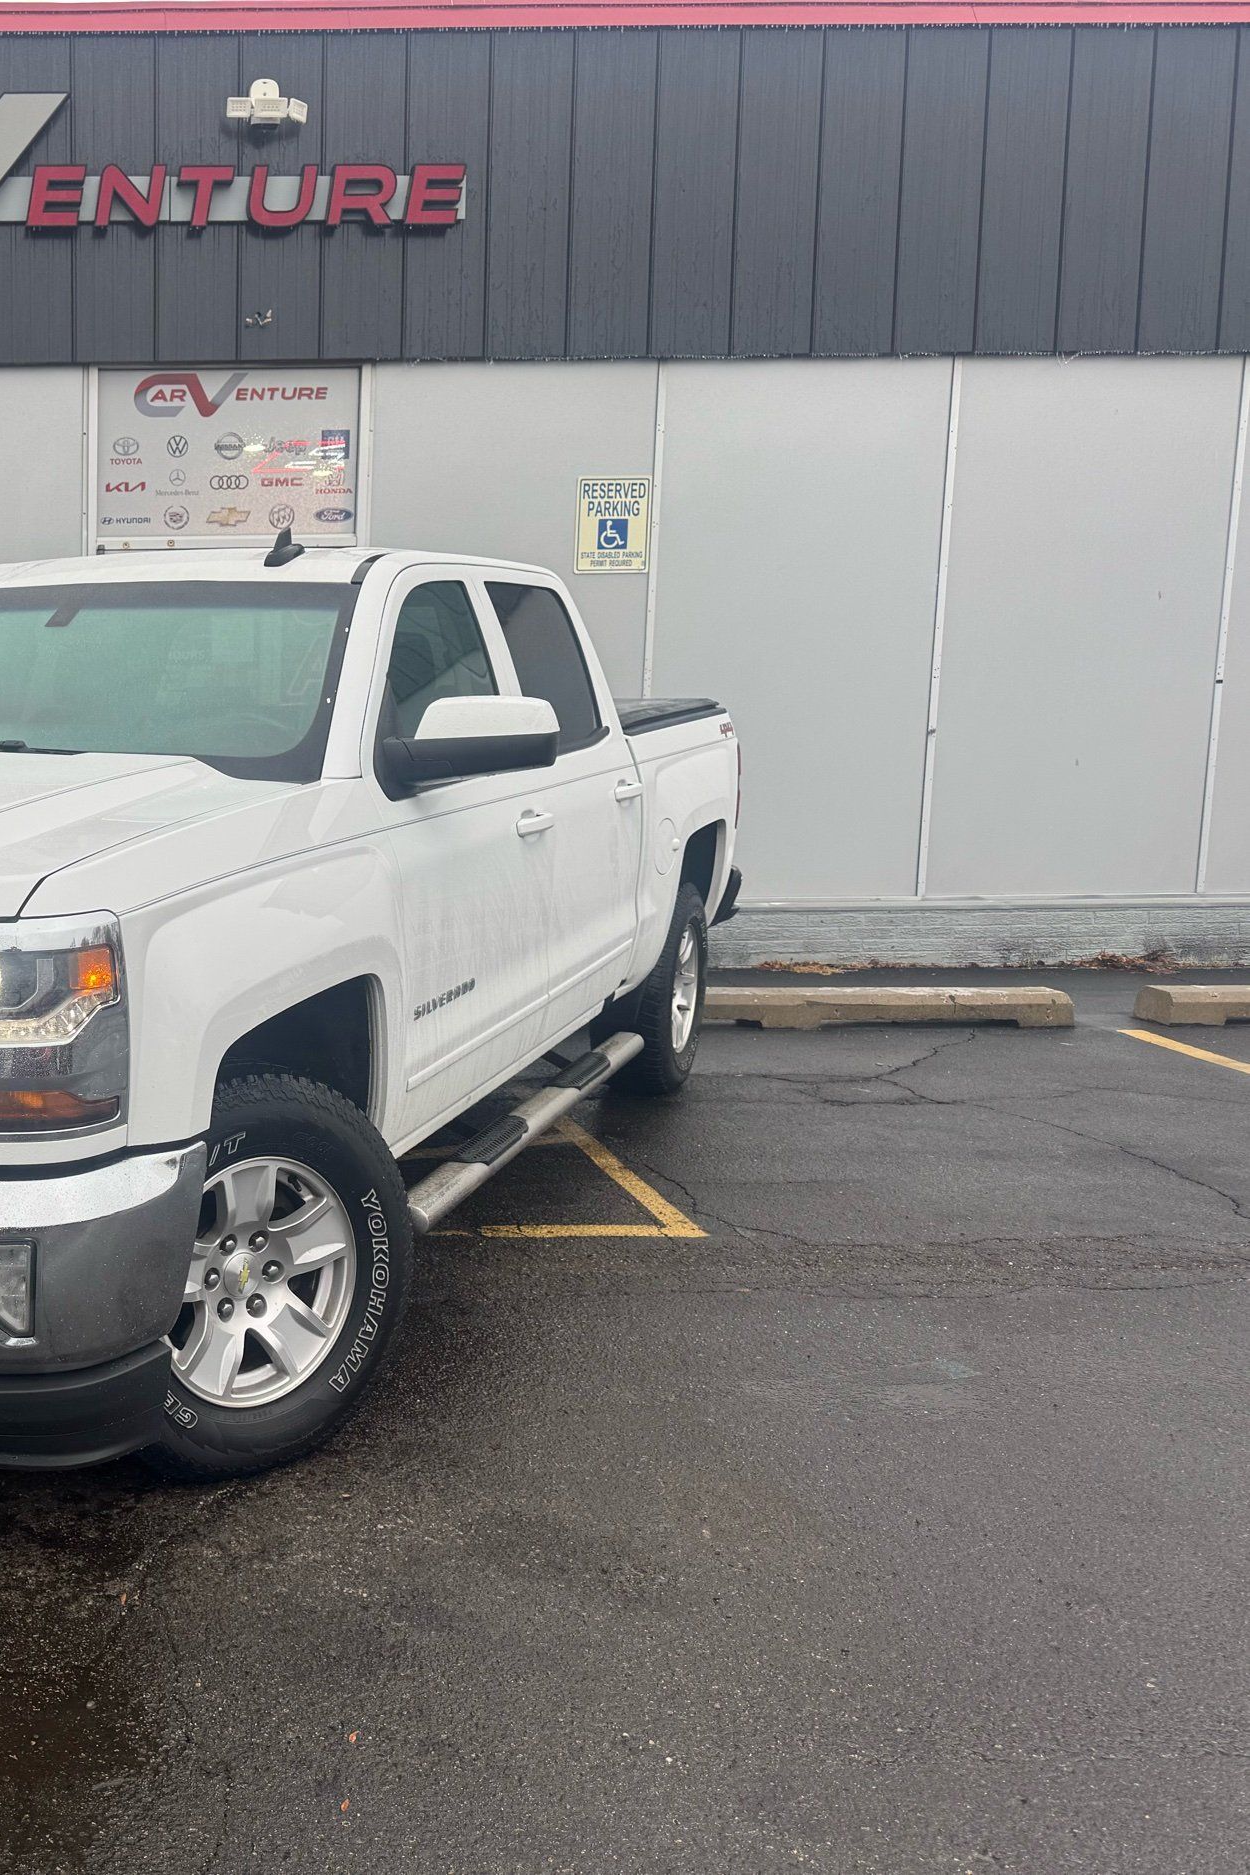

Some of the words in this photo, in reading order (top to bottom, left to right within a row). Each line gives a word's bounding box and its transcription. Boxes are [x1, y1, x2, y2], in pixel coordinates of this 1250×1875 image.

[105, 481, 146, 493] KIA
[261, 477, 305, 487] GMC
[582, 483, 646, 499] RESERVED
[321, 510, 346, 520] Ford
[587, 500, 640, 517] PARKING
[609, 559, 632, 567] REQUIRED
[413, 977, 476, 1021] SILVERADO
[328, 1188, 393, 1393] YOKOHAMA
